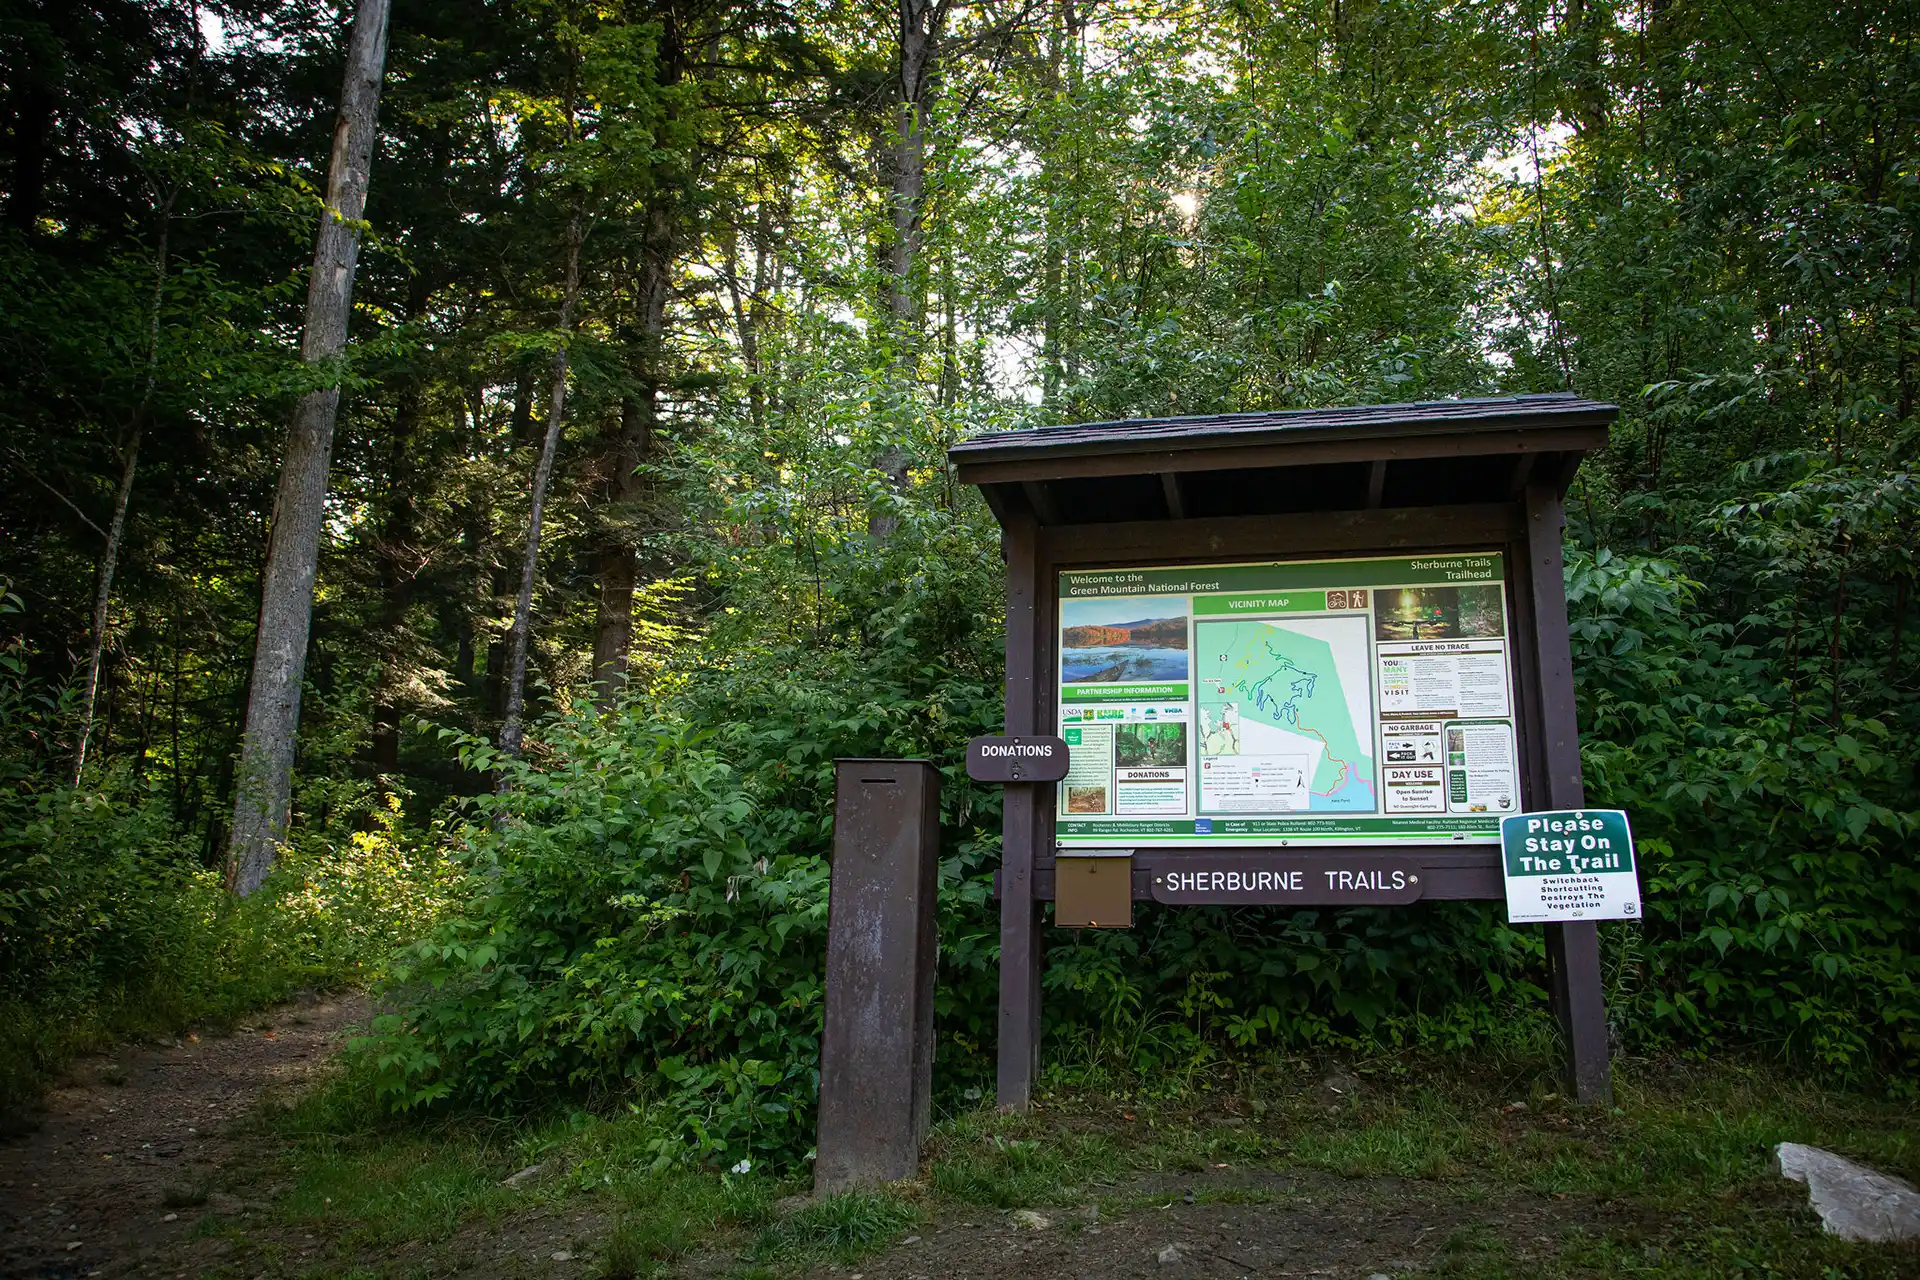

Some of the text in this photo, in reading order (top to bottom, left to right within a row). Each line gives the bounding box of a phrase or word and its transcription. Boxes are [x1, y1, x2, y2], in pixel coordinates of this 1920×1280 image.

[1411, 558, 1491, 570] Sherburne Trails
[1070, 573, 1144, 585] Welcome to the
[1446, 569, 1492, 580] Trailhead
[1070, 582, 1220, 596] Green Mountain National Forest
[1228, 599, 1290, 608] VICINITY MAP
[1412, 644, 1433, 652] LEAVE
[981, 745, 1052, 758] DONATIONS
[1528, 818, 1604, 834] Please
[1525, 834, 1610, 854] Stay On
[1520, 853, 1619, 872] The Trail
[1166, 870, 1406, 892] SHERBURNE TRAILS
[1542, 876, 1600, 884] Switchback
[1540, 884, 1604, 893] Shortcutting
[1540, 894, 1584, 902] Destroys
[1546, 902, 1601, 910] Vegetation
